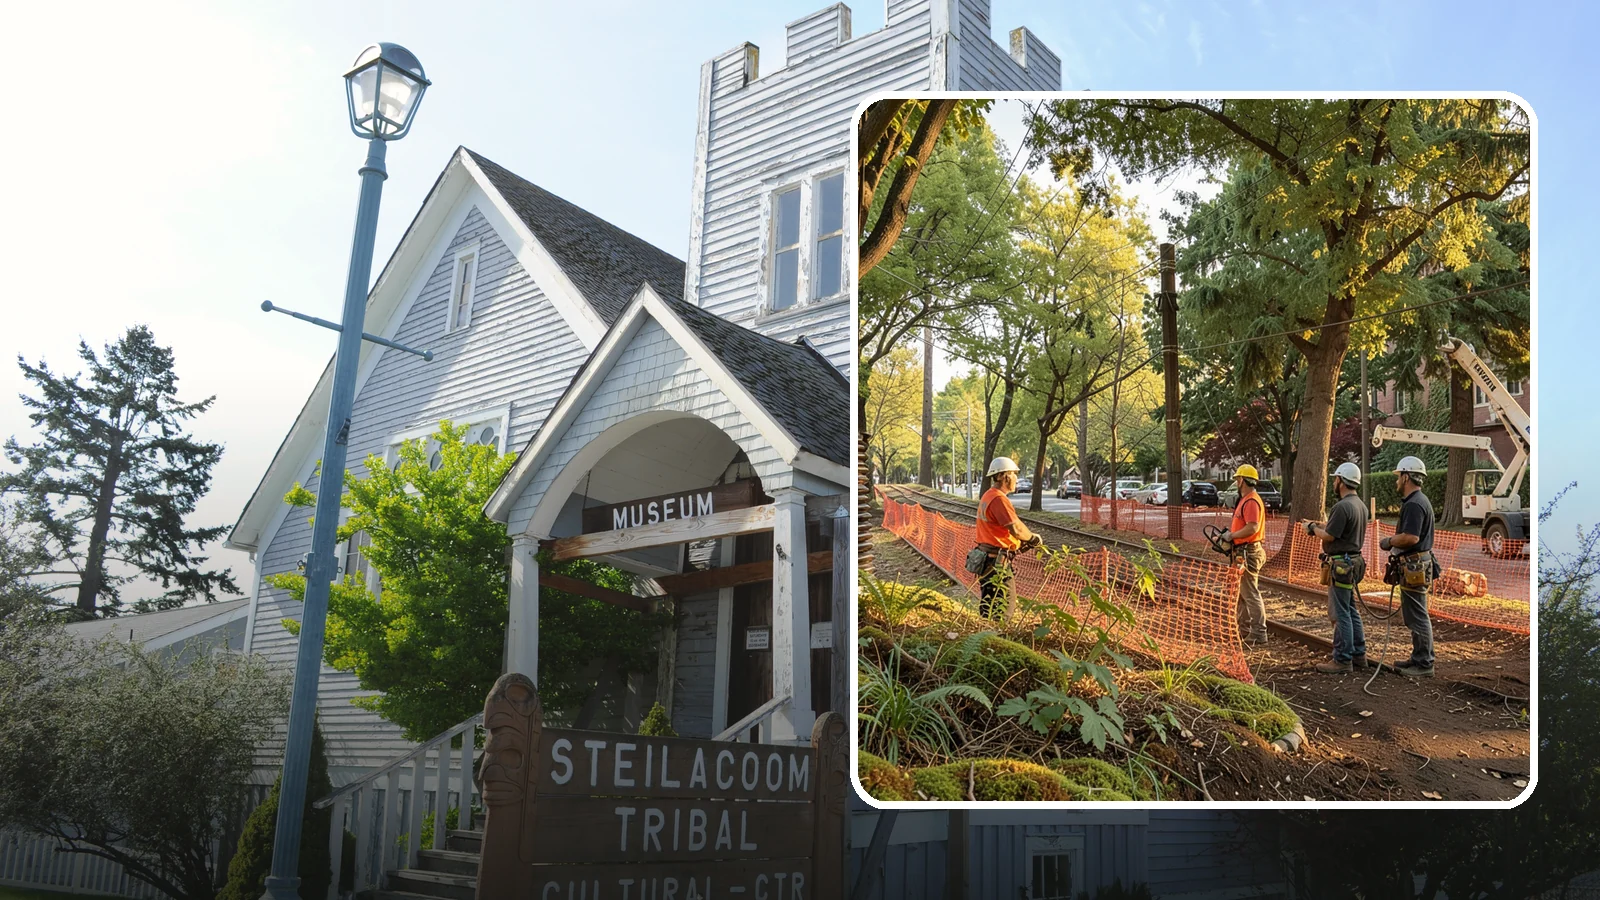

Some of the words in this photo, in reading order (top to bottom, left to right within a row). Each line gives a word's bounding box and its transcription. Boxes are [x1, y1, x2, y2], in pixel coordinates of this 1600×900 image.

[612, 491, 714, 531] MUSEUM
[551, 738, 809, 793] STEILACOOM
[615, 806, 757, 851] TRIBAL
